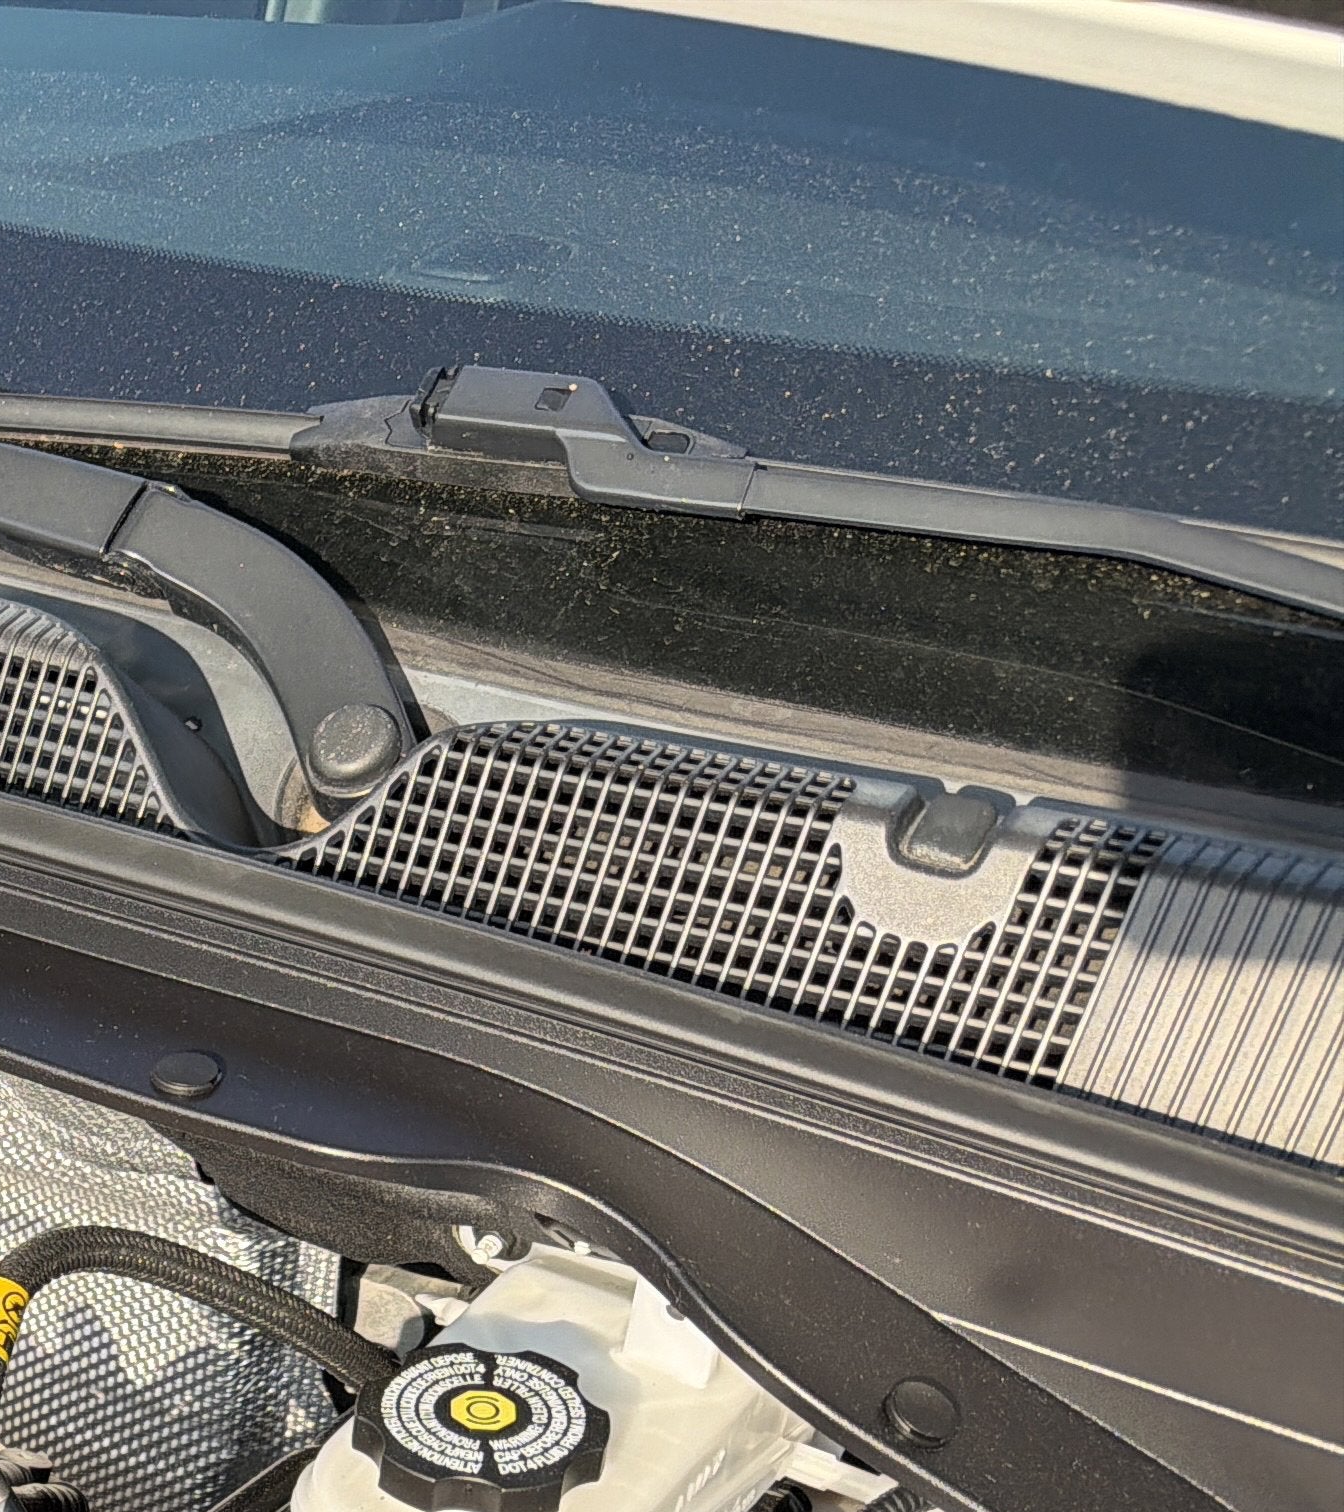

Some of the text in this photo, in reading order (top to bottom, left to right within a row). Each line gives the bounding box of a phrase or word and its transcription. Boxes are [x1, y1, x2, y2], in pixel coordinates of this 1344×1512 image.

[451, 1363, 476, 1374] DOT
[475, 1364, 485, 1374] 4
[492, 1364, 531, 1382] ONLY
[436, 1374, 484, 1390] SCELLE
[491, 1375, 536, 1398] FILLER
[524, 1376, 552, 1394] USE
[523, 1394, 547, 1424] CLEAN
[556, 1386, 585, 1418] SEALED
[519, 1430, 561, 1457] BEFORE
[558, 1424, 585, 1449] FROM
[492, 1448, 525, 1461] CAP
[531, 1445, 570, 1467] FLUID
[497, 1460, 530, 1475] DOT
[522, 1458, 539, 1470] 4
